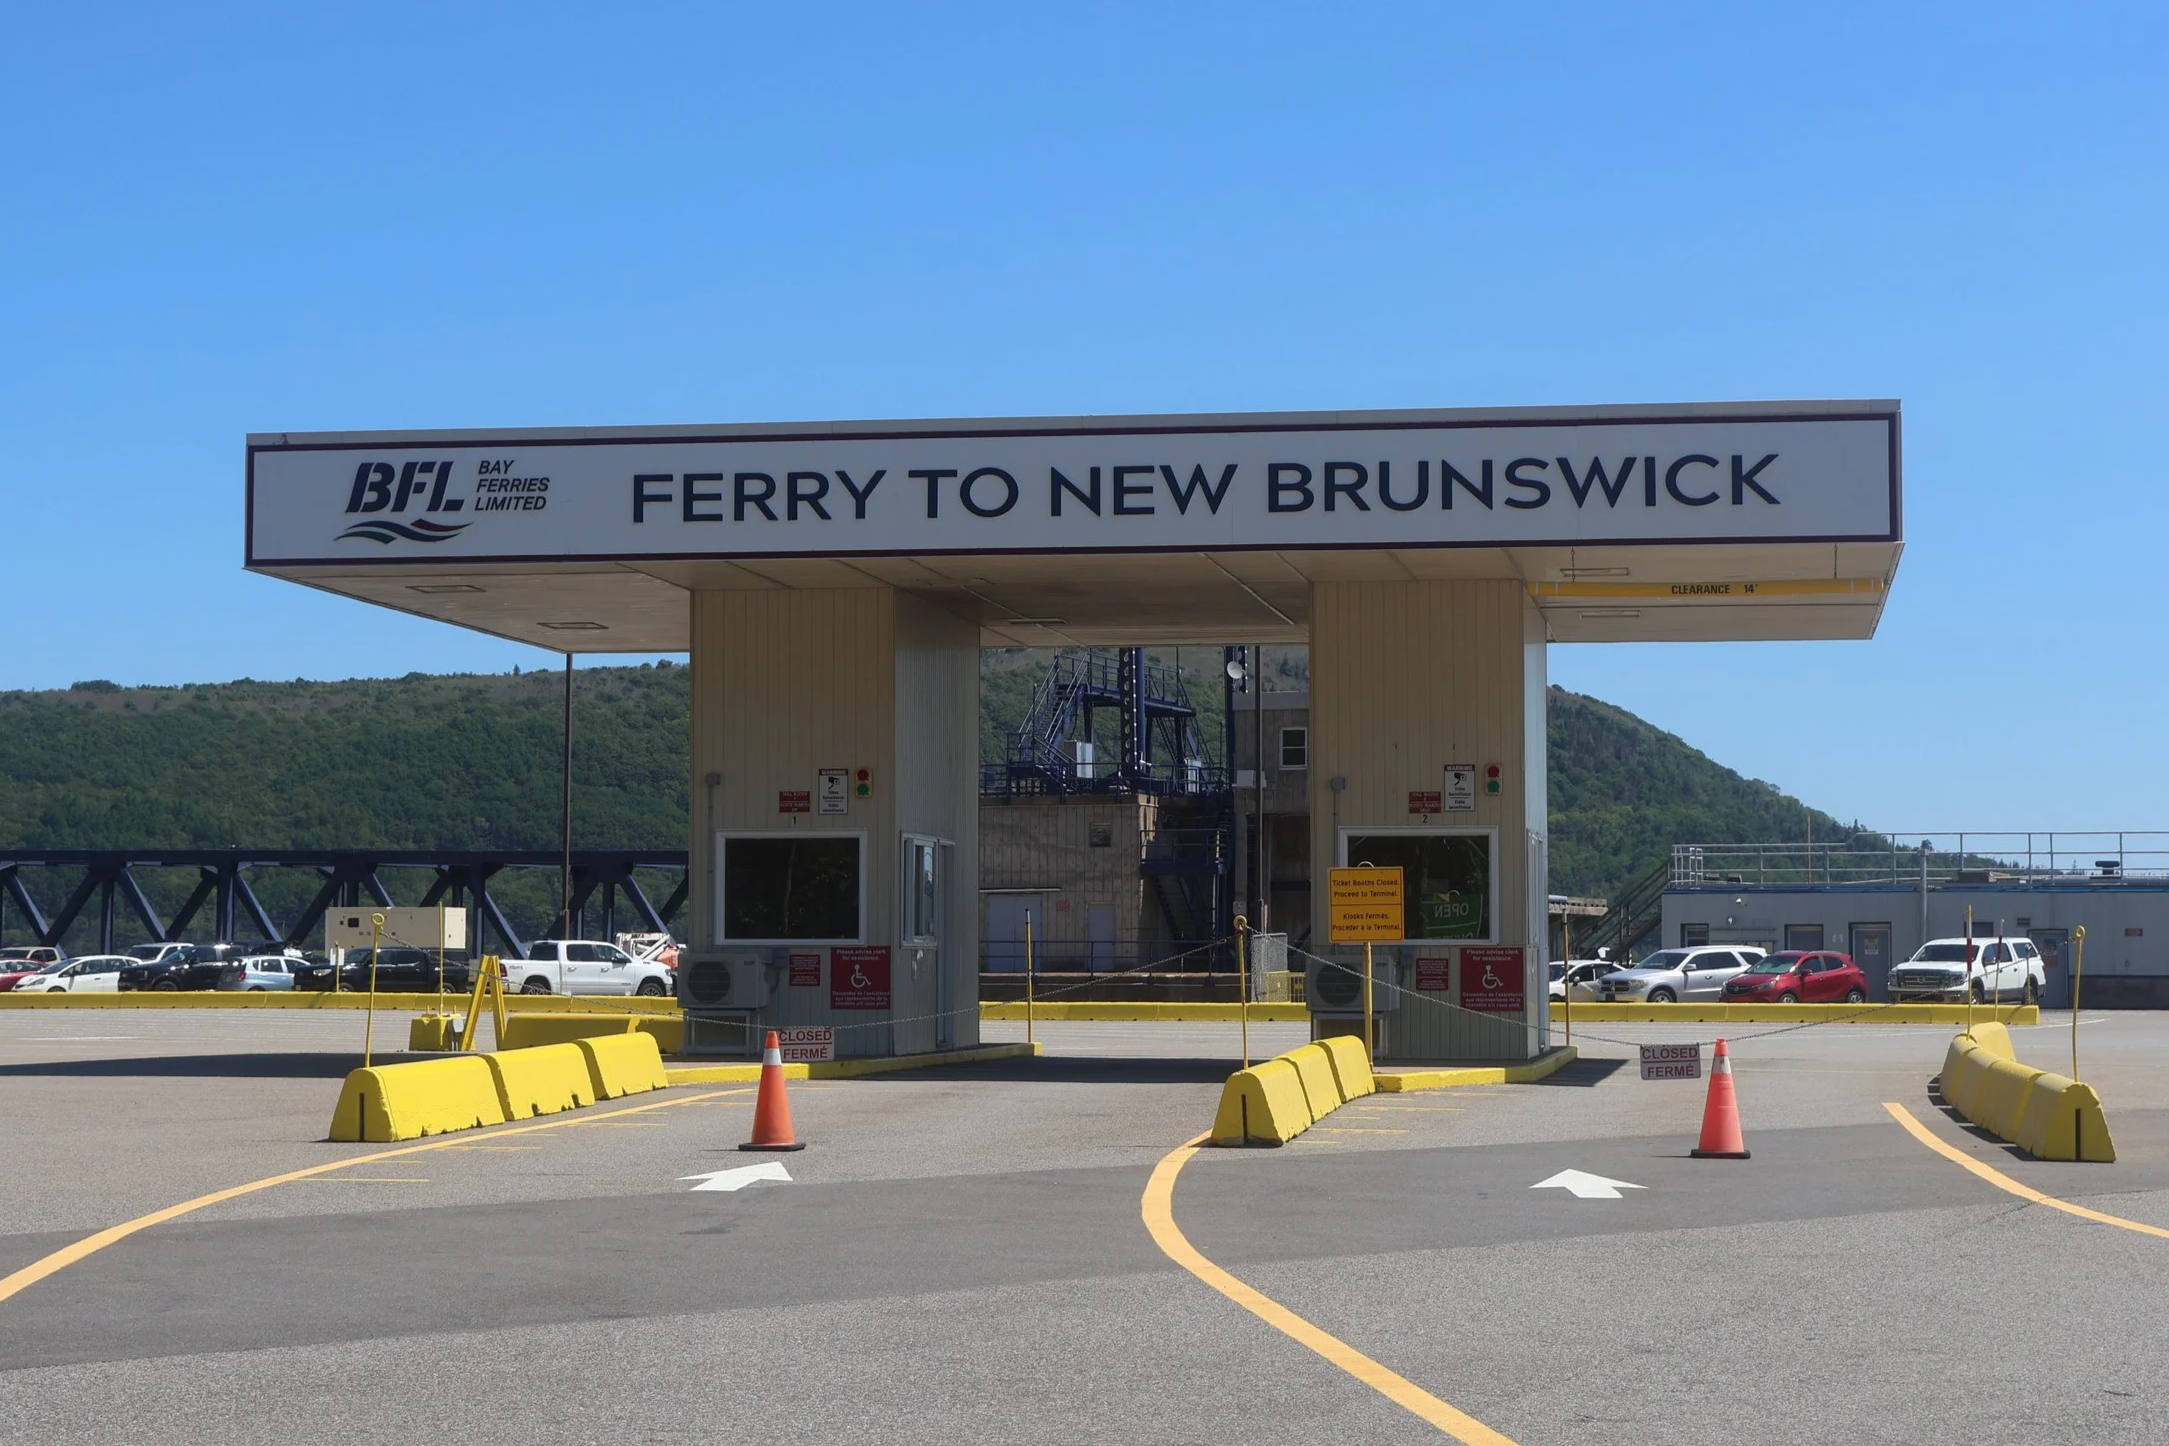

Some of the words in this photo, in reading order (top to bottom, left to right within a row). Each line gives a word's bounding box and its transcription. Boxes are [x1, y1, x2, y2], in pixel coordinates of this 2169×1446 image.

[478, 460, 515, 475] BAY
[345, 461, 465, 513] BFL
[476, 477, 550, 493] FERRIES
[633, 469, 886, 523] FERRY
[908, 467, 1019, 519] TO
[1050, 463, 1239, 517] NEW
[1267, 453, 1781, 514] BRUNSWICK
[474, 496, 547, 511] LIMITED
[1671, 584, 1730, 595] CLEARANCE
[1743, 583, 1758, 594] 14'
[793, 816, 797, 825] 1
[1422, 814, 1428, 823] 2
[778, 1030, 832, 1042] CLOSED
[783, 1045, 828, 1059] FERMÉ
[1642, 1047, 1698, 1060] CLOSED
[1647, 1063, 1695, 1077] FERMÉ
